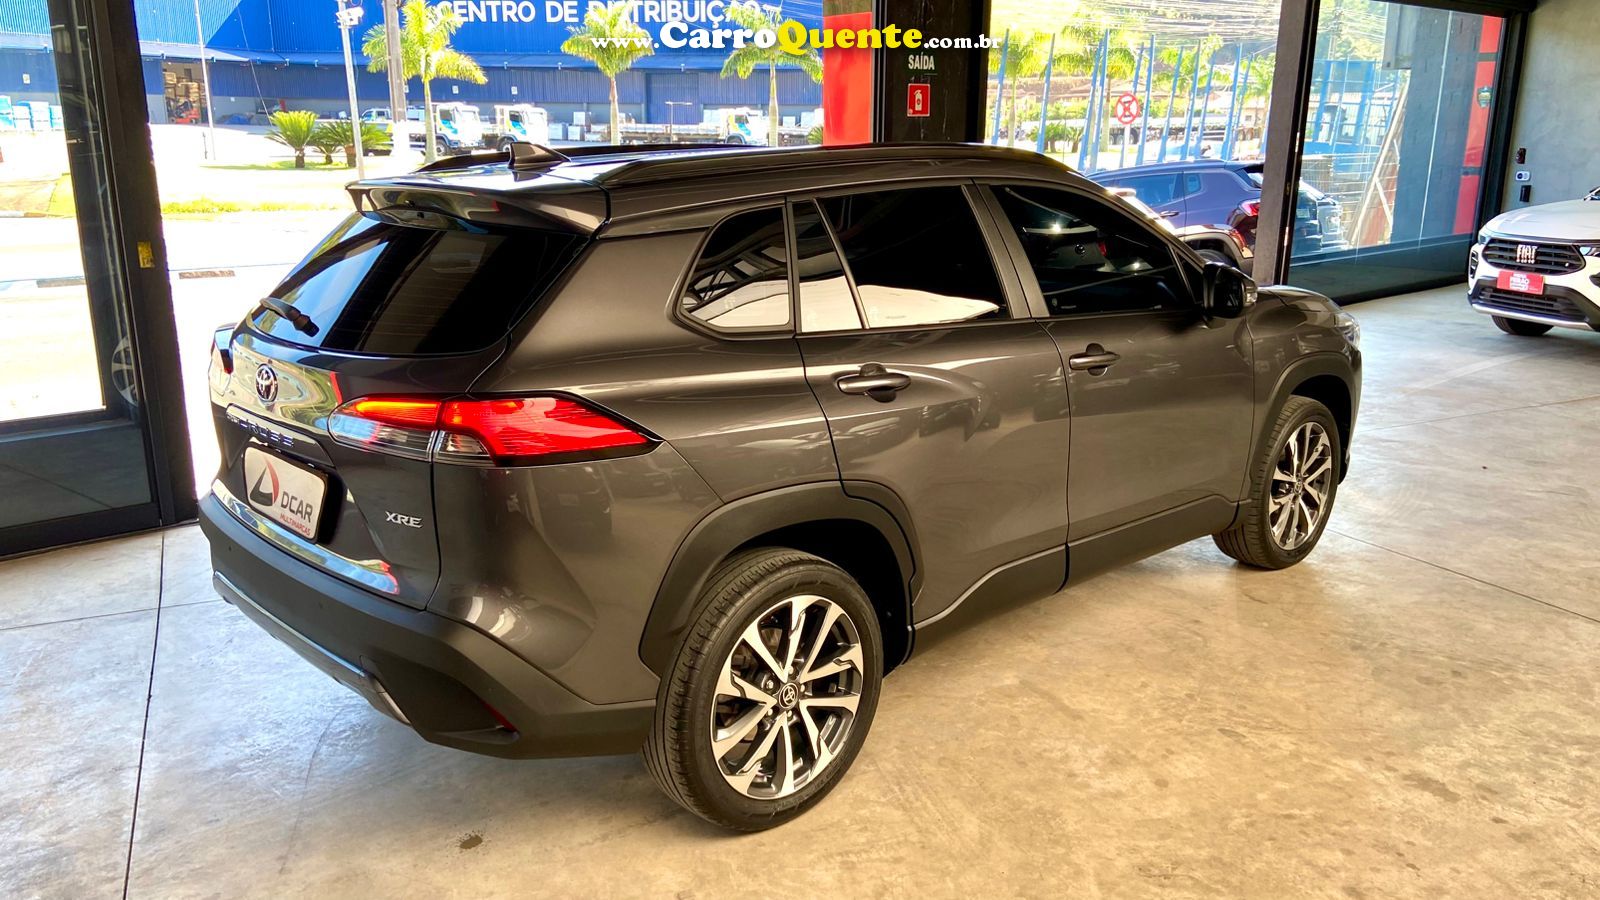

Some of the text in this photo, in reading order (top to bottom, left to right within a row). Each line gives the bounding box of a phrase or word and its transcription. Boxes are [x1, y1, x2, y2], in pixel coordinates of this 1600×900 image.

[545, 0, 579, 22] DE
[908, 52, 935, 71] SAÍDA
[1516, 244, 1538, 264] FIAT
[280, 491, 313, 523] DCAR
[385, 510, 423, 528] XRE
